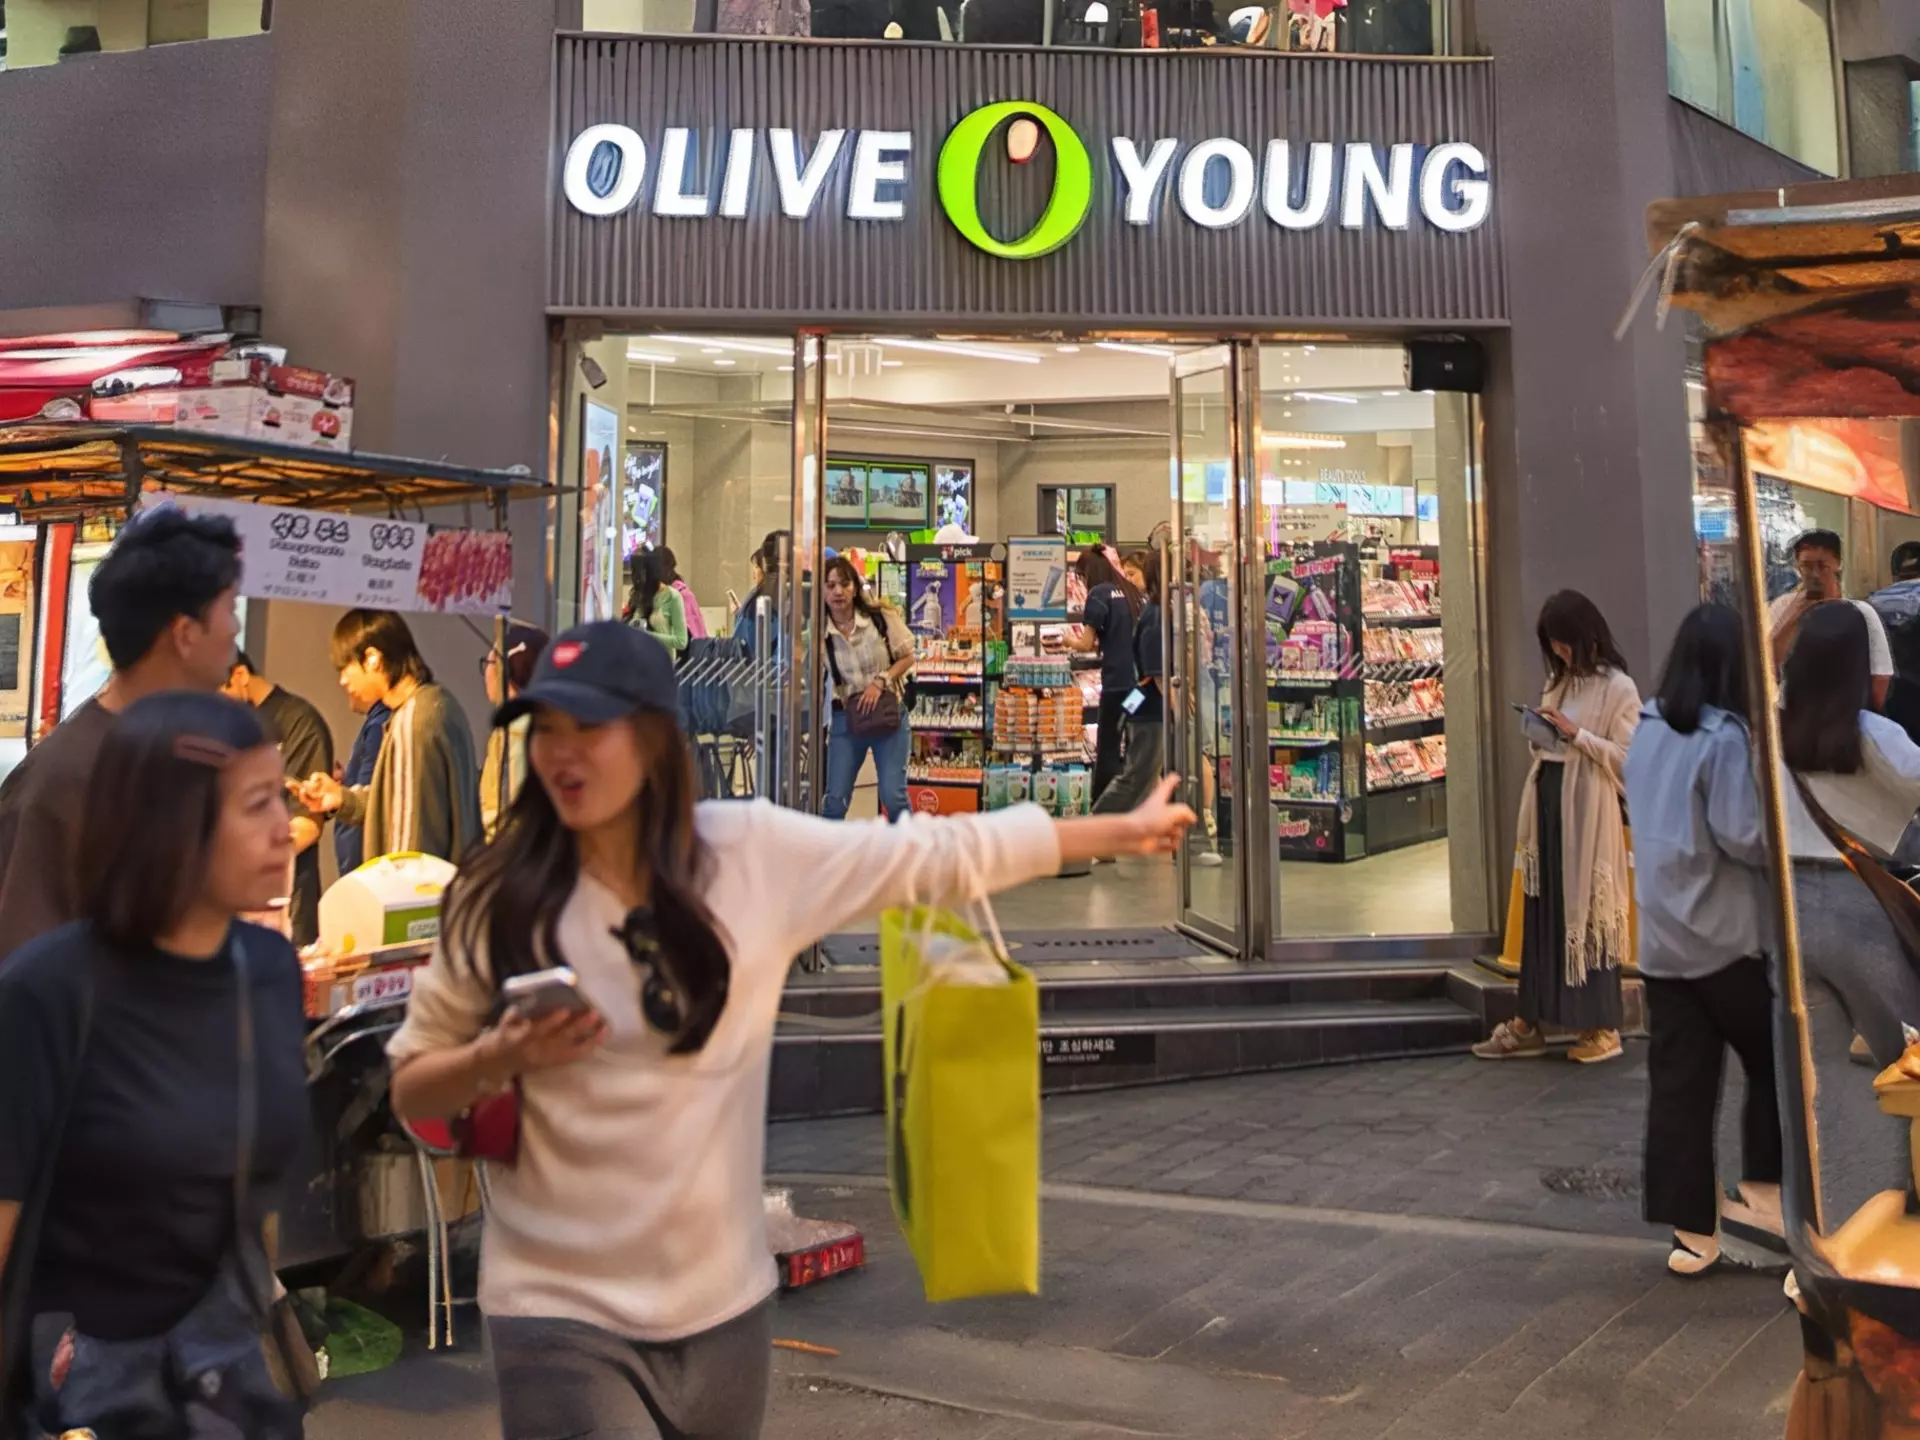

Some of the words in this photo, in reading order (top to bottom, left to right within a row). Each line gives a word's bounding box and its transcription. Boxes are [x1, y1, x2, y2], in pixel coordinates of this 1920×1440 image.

[563, 123, 912, 220] OLIVE
[1112, 136, 1490, 231] YOUNG
[1345, 469, 1367, 484] TOOLS
